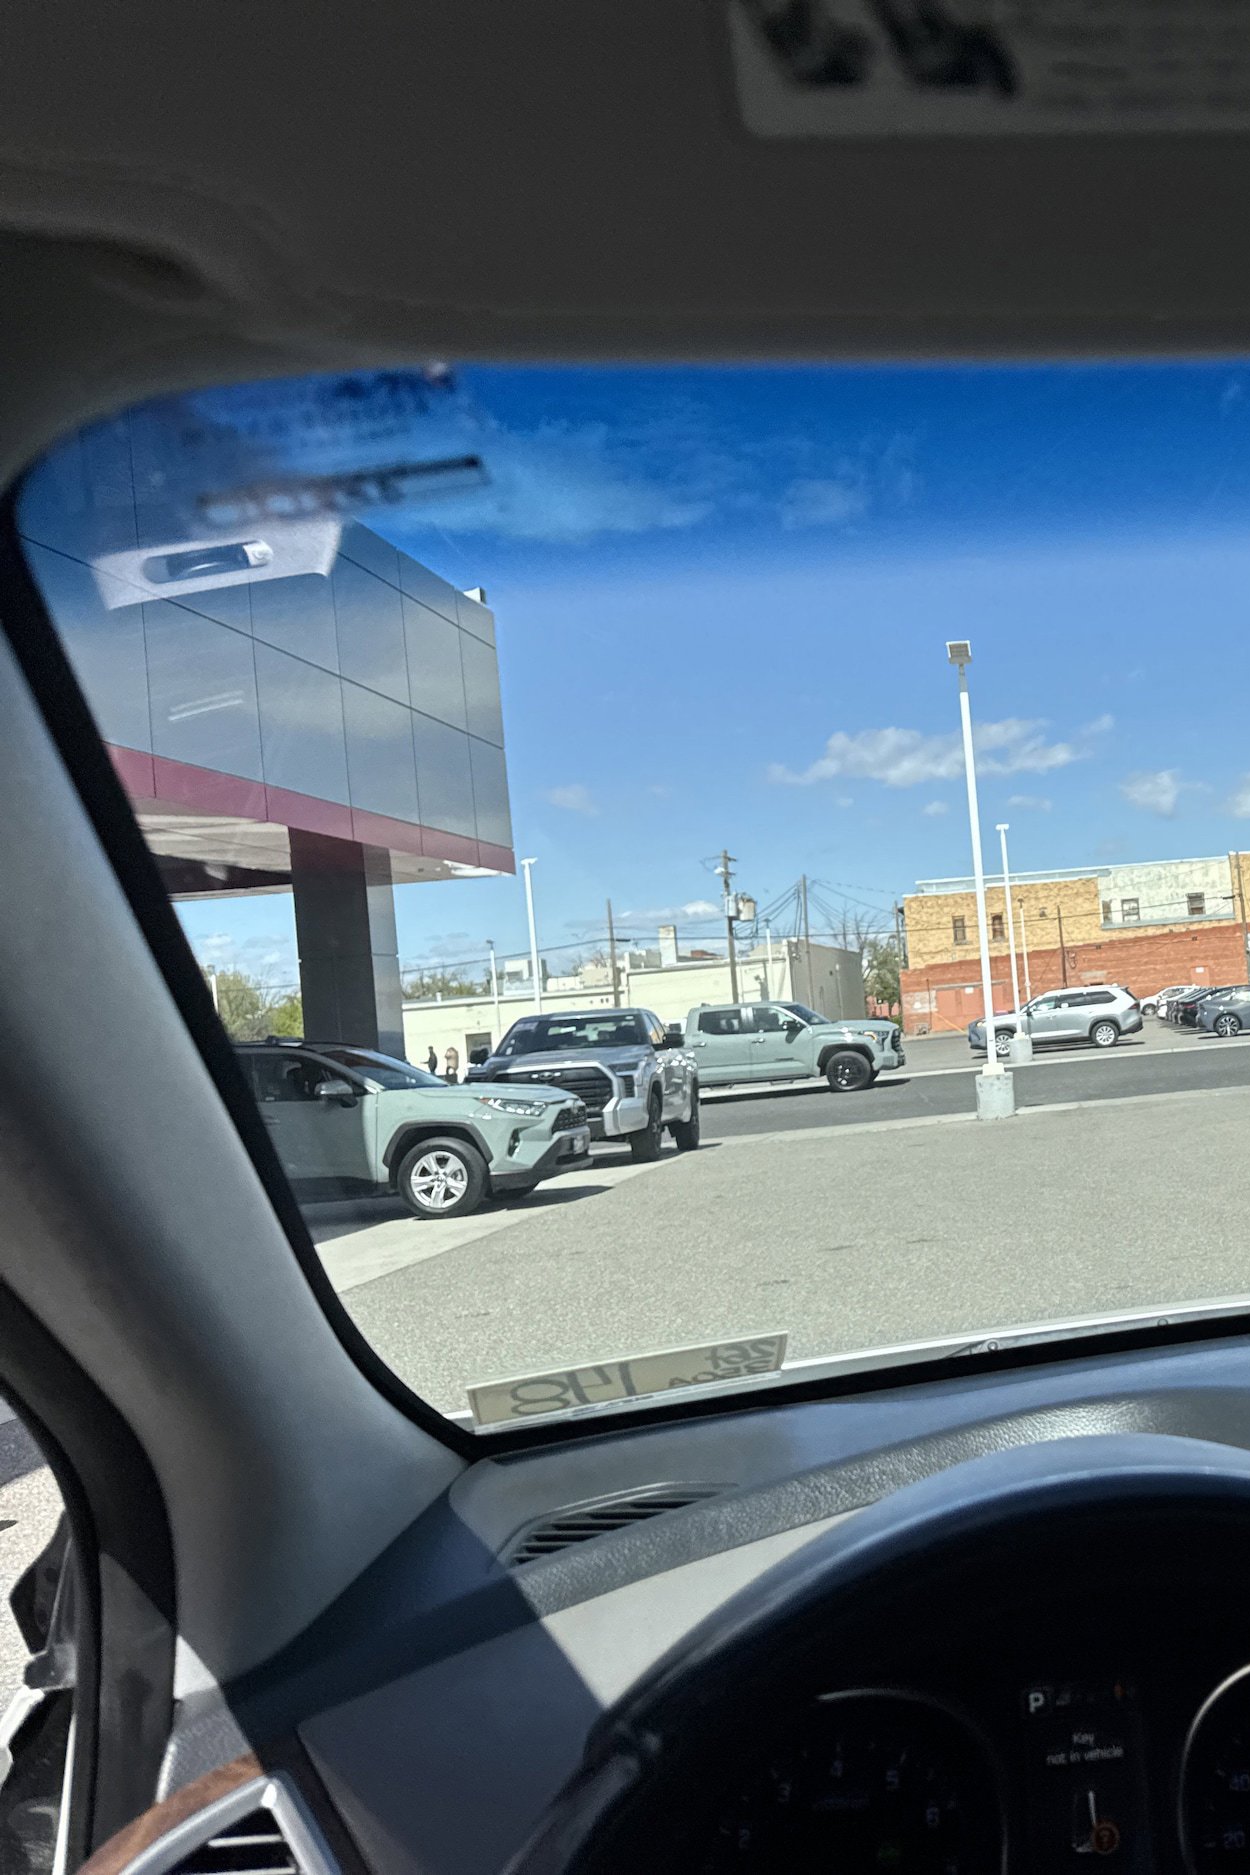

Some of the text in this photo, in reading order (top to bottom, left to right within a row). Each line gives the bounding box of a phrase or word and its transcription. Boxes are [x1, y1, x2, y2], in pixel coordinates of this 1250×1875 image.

[1028, 1691, 1045, 1714] P
[1072, 1732, 1095, 1747] Key
[1046, 1745, 1124, 1766] not in vehicle
